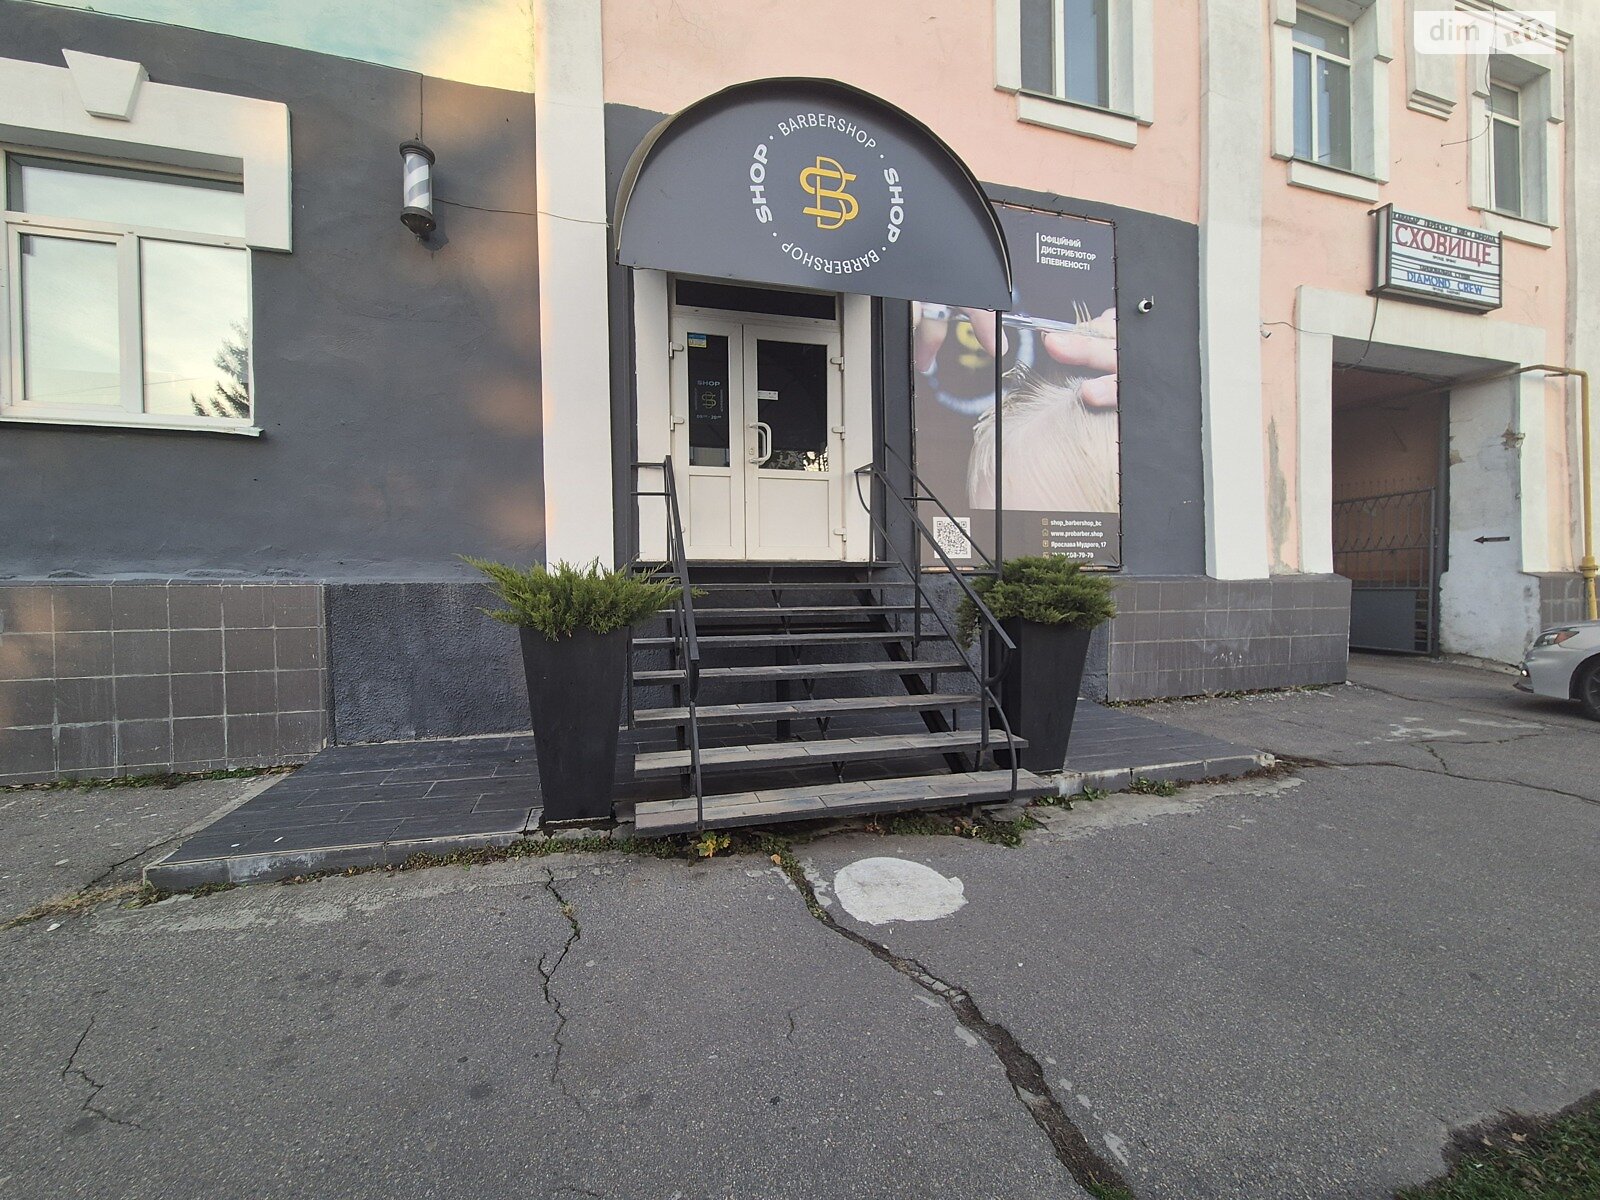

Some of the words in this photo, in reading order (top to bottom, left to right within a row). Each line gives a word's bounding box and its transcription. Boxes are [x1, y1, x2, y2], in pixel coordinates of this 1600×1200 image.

[777, 113, 877, 149] BARBERSHOP
[749, 143, 773, 224] SHOP
[883, 167, 905, 243] SHOP
[781, 242, 881, 275] BARBERSHOP
[1040, 256, 1090, 271] ВПЕВНЕНОСТІ
[1395, 224, 1492, 267] СХОВИЩЕ
[1407, 271, 1451, 288] DIAMOND
[1457, 282, 1483, 294] CREW
